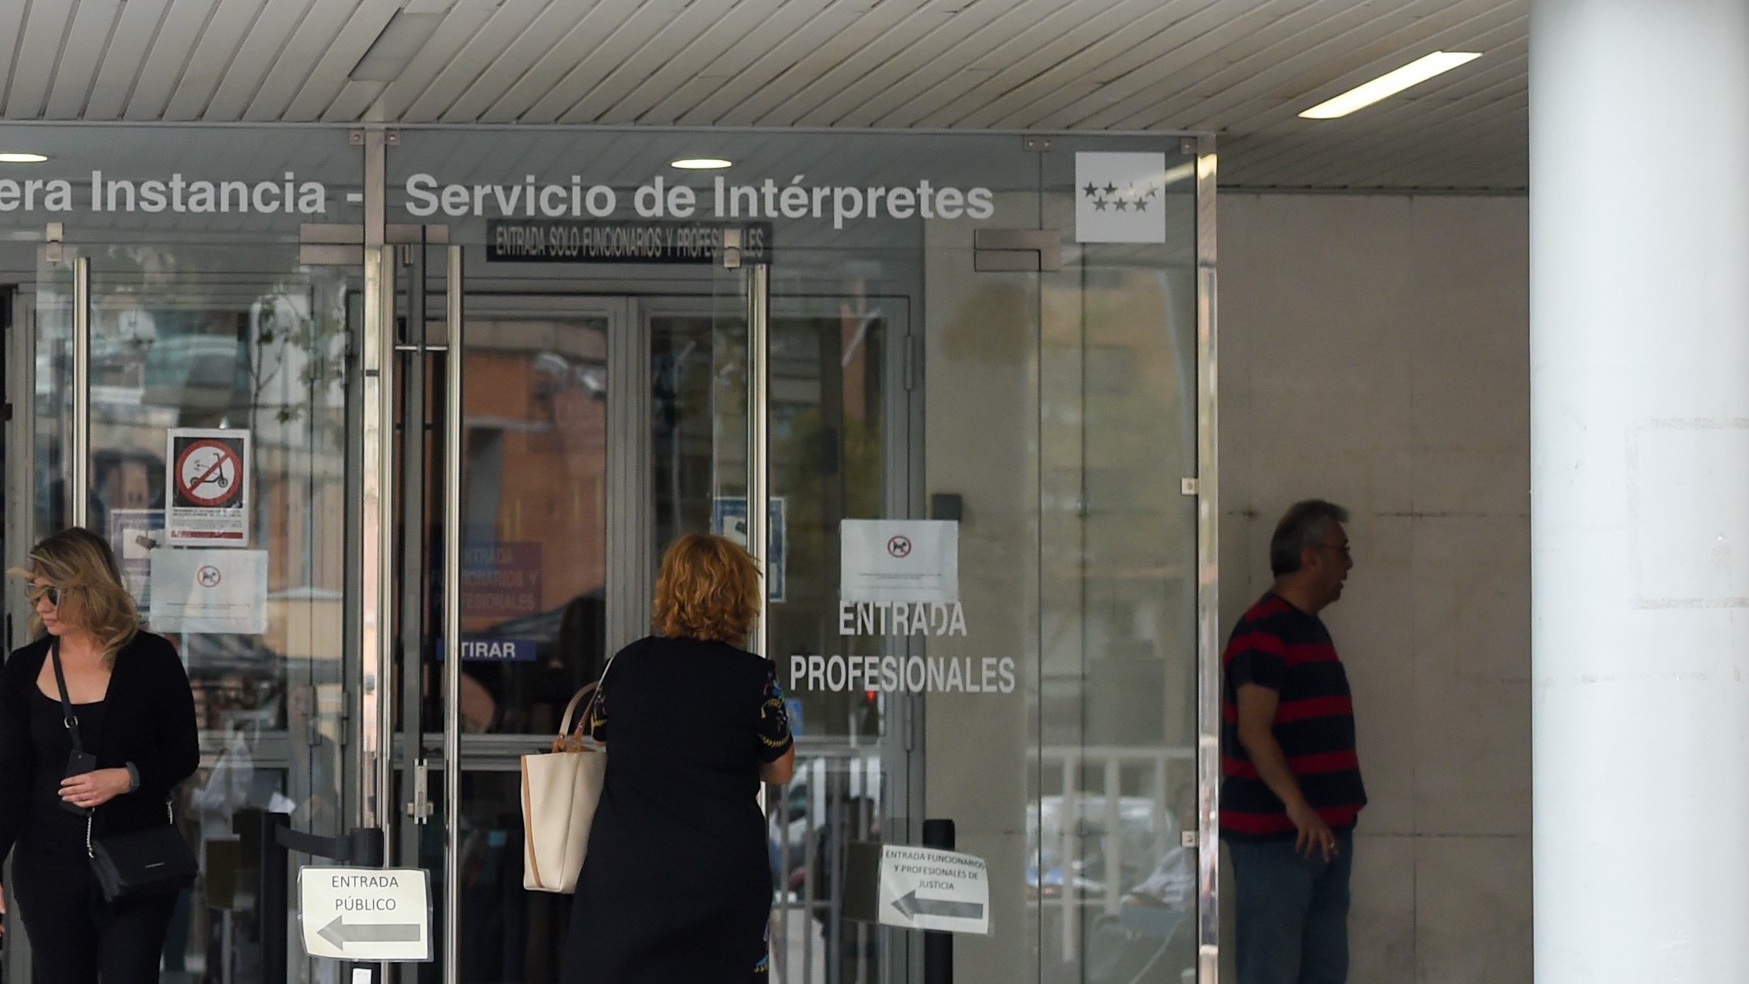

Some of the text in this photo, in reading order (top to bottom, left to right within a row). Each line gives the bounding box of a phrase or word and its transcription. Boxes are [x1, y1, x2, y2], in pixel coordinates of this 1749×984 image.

[92, 170, 327, 215] Instancia
[404, 173, 618, 219] Servicio
[634, 174, 696, 219] de
[716, 174, 994, 229] Intérpretes
[496, 226, 545, 255] ENTRADA
[550, 227, 579, 256] SOLO
[583, 227, 662, 257] FUNCIONARIOS
[666, 228, 673, 257] Y
[839, 600, 968, 636] ENTRADA
[460, 641, 516, 658] TIRAR
[790, 654, 1016, 694] PROFESIONALES
[885, 850, 926, 861] ENTRADA
[893, 864, 979, 880] Y PROFESIONALES DE
[331, 875, 399, 888] ENTRADA
[919, 881, 954, 890] JUSTICIA
[335, 896, 396, 911] PÚBLICO
